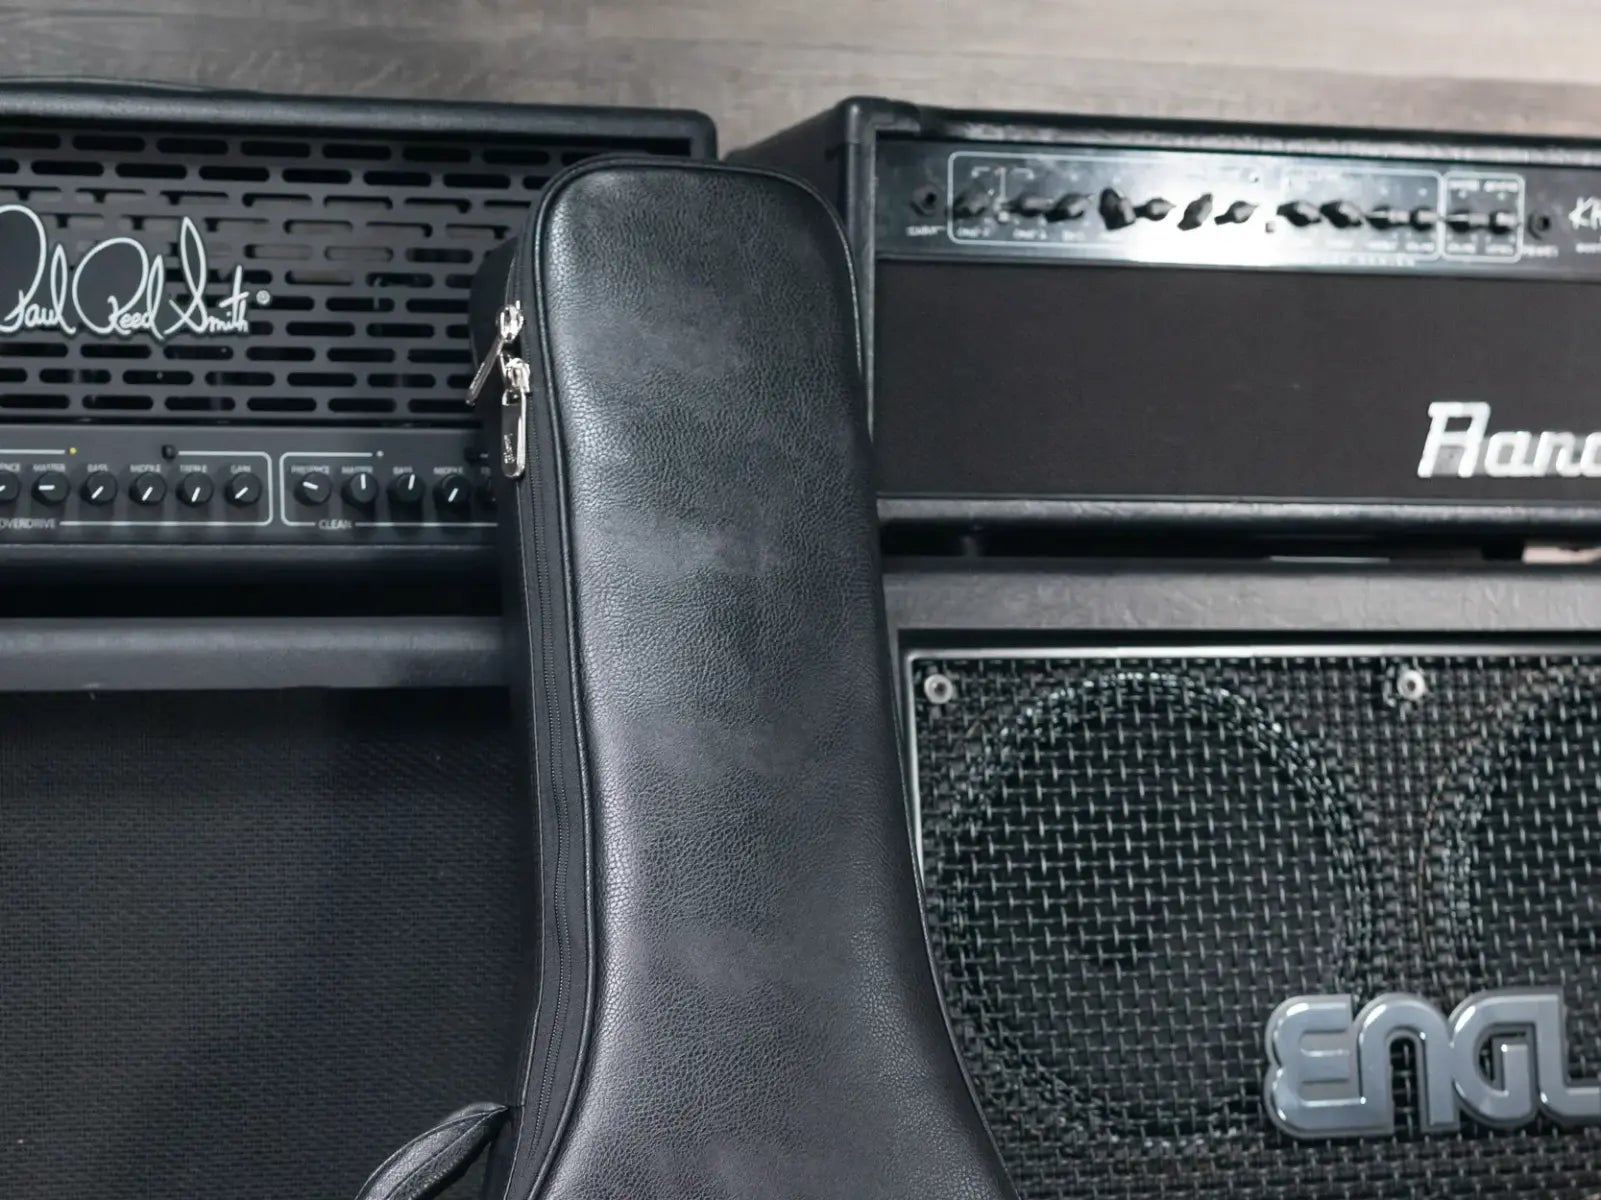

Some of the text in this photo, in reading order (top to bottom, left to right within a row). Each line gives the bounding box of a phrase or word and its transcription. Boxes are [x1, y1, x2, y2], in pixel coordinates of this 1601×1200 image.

[72, 236, 164, 340] Reed
[163, 216, 250, 334] Smith
[318, 519, 353, 530] CLEAN
